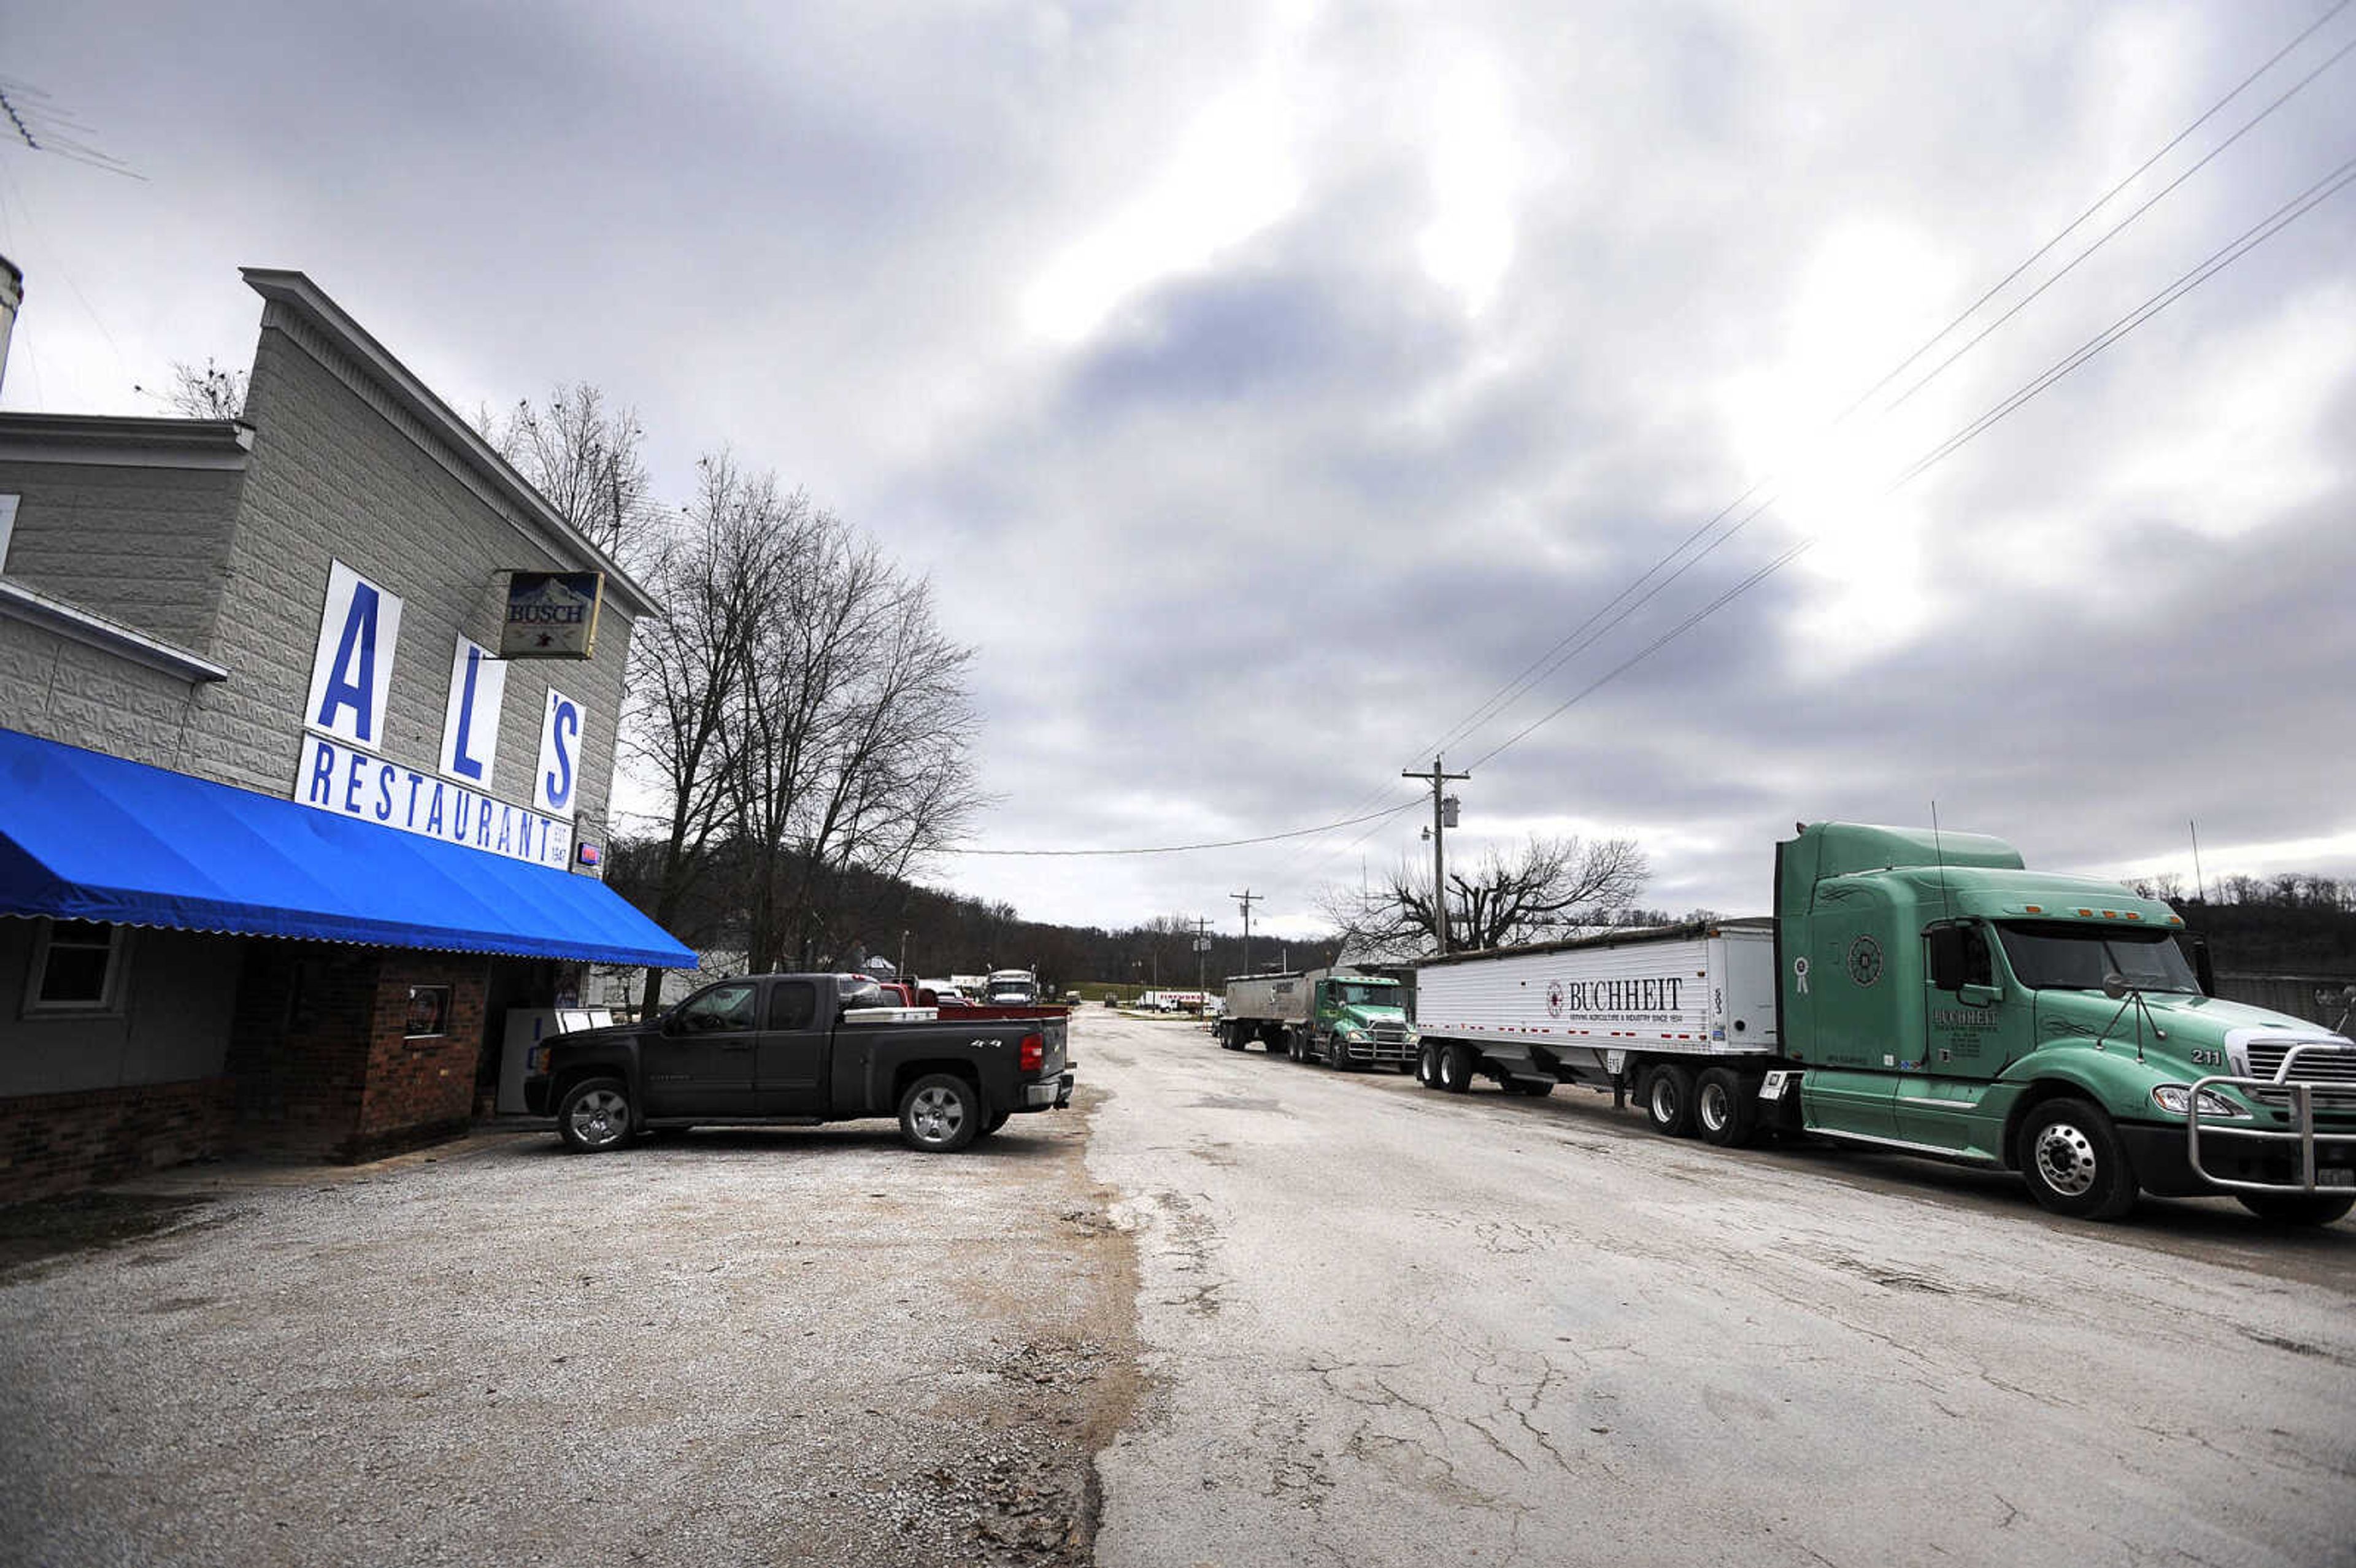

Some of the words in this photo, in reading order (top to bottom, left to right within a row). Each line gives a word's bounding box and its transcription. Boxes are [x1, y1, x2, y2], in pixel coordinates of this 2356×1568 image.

[510, 604, 582, 623] BUSCH
[310, 742, 551, 861] RESTAURANT
[1569, 977, 1683, 1011] BUCHHEIT
[2191, 1049, 2222, 1066] 211
